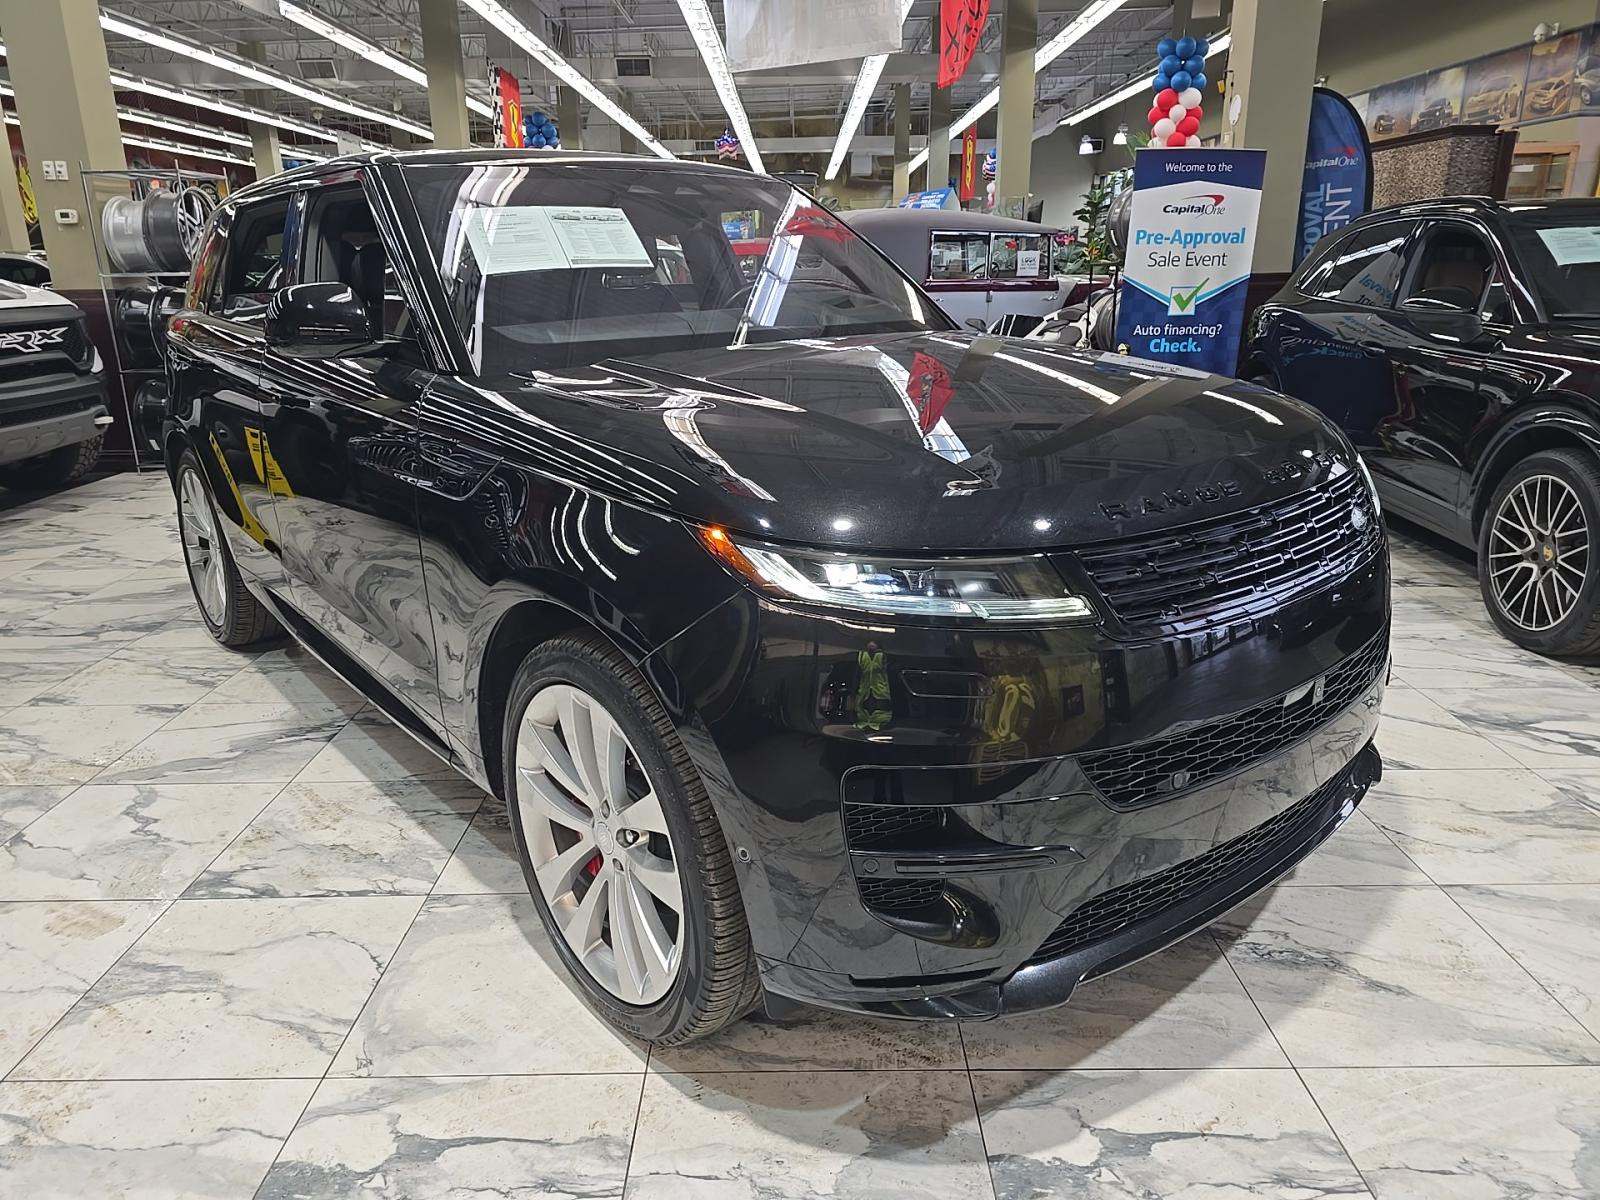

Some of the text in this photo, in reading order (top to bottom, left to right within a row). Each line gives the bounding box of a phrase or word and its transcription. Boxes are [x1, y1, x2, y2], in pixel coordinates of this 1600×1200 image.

[1165, 162, 1233, 172] Welcome to the
[1135, 228, 1246, 249] Pre-Approval
[1147, 250, 1228, 267] Sale Event
[1133, 323, 1223, 338] Auto financing?
[1149, 337, 1202, 353] Check.
[1098, 479, 1243, 521] RANGE
